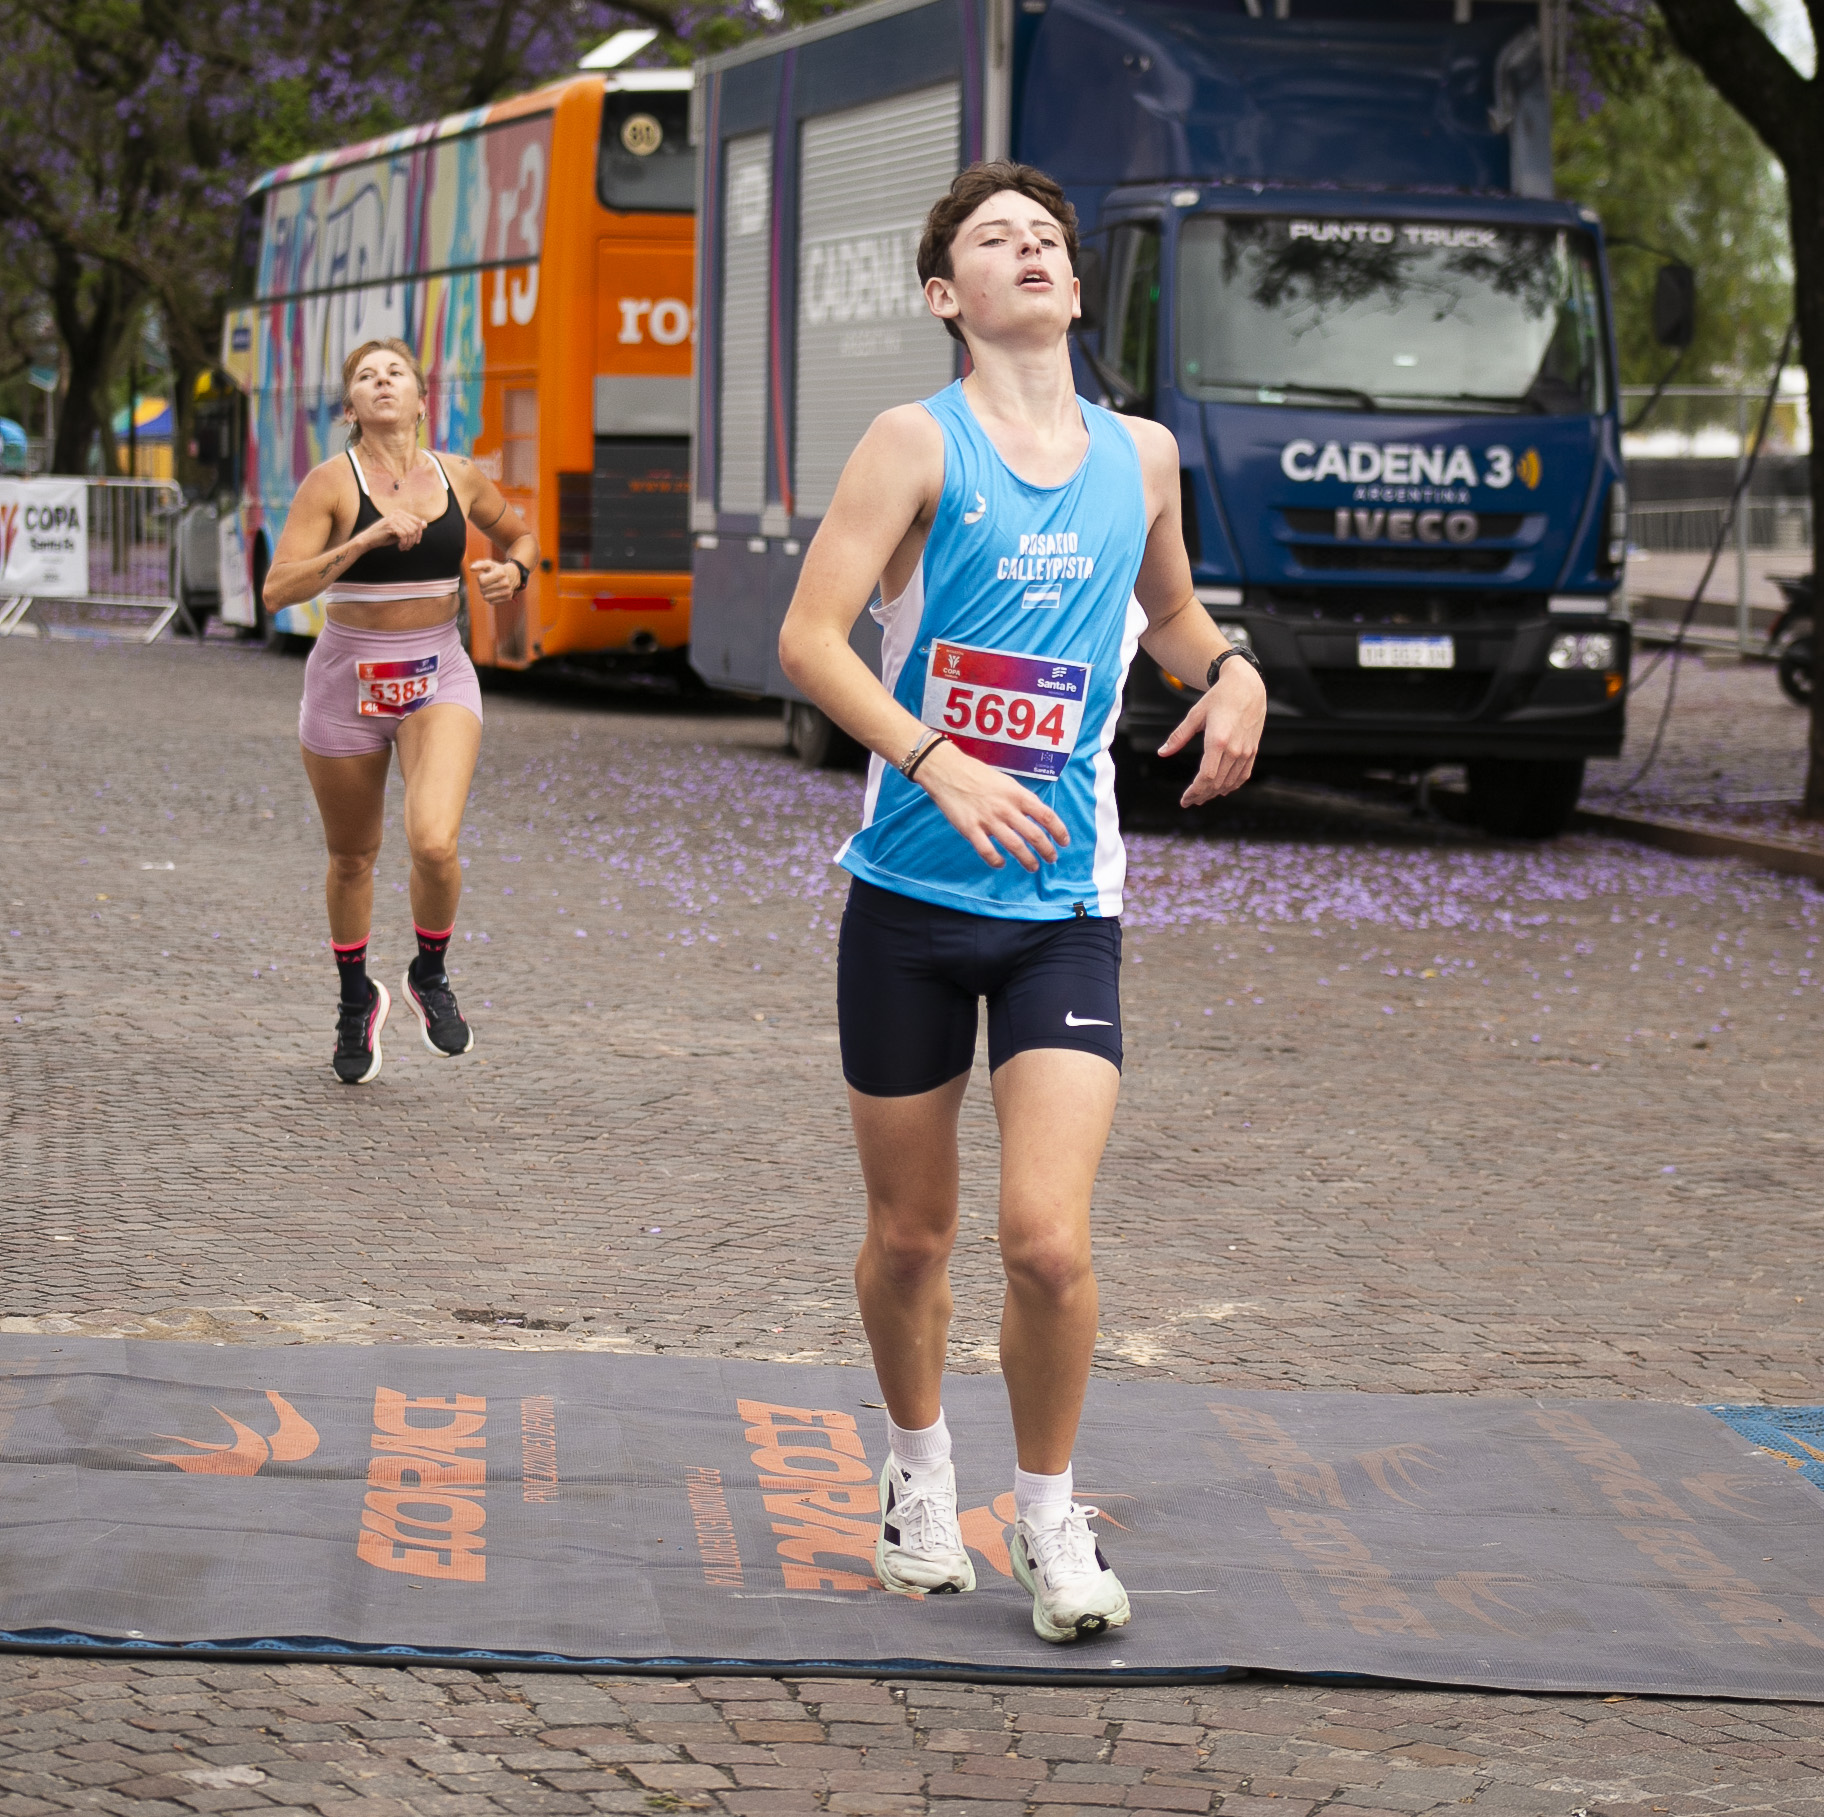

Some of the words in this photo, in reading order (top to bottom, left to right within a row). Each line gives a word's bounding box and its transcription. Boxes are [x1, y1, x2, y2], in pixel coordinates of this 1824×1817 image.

[1289, 219, 1395, 244] PUNTO
[1402, 224, 1499, 248] TRUCK
[617, 297, 699, 346] ro
[1280, 439, 1480, 488] CADENA
[1483, 445, 1514, 489] 3
[1353, 484, 1472, 504] ARGENTINA
[24, 505, 80, 531] COPA
[1334, 506, 1479, 545] IVECO
[1020, 532, 1078, 556] ROSARIO
[997, 556, 1094, 581] CALLEYPISTA
[942, 667, 961, 676] COPA
[1036, 678, 1066, 692] Santa
[1066, 682, 1077, 693] Fe
[370, 676, 429, 704] 5383
[942, 686, 1065, 746] 5694
[357, 1386, 487, 1583] ECORACE
[736, 1398, 925, 1601] ECORACE
